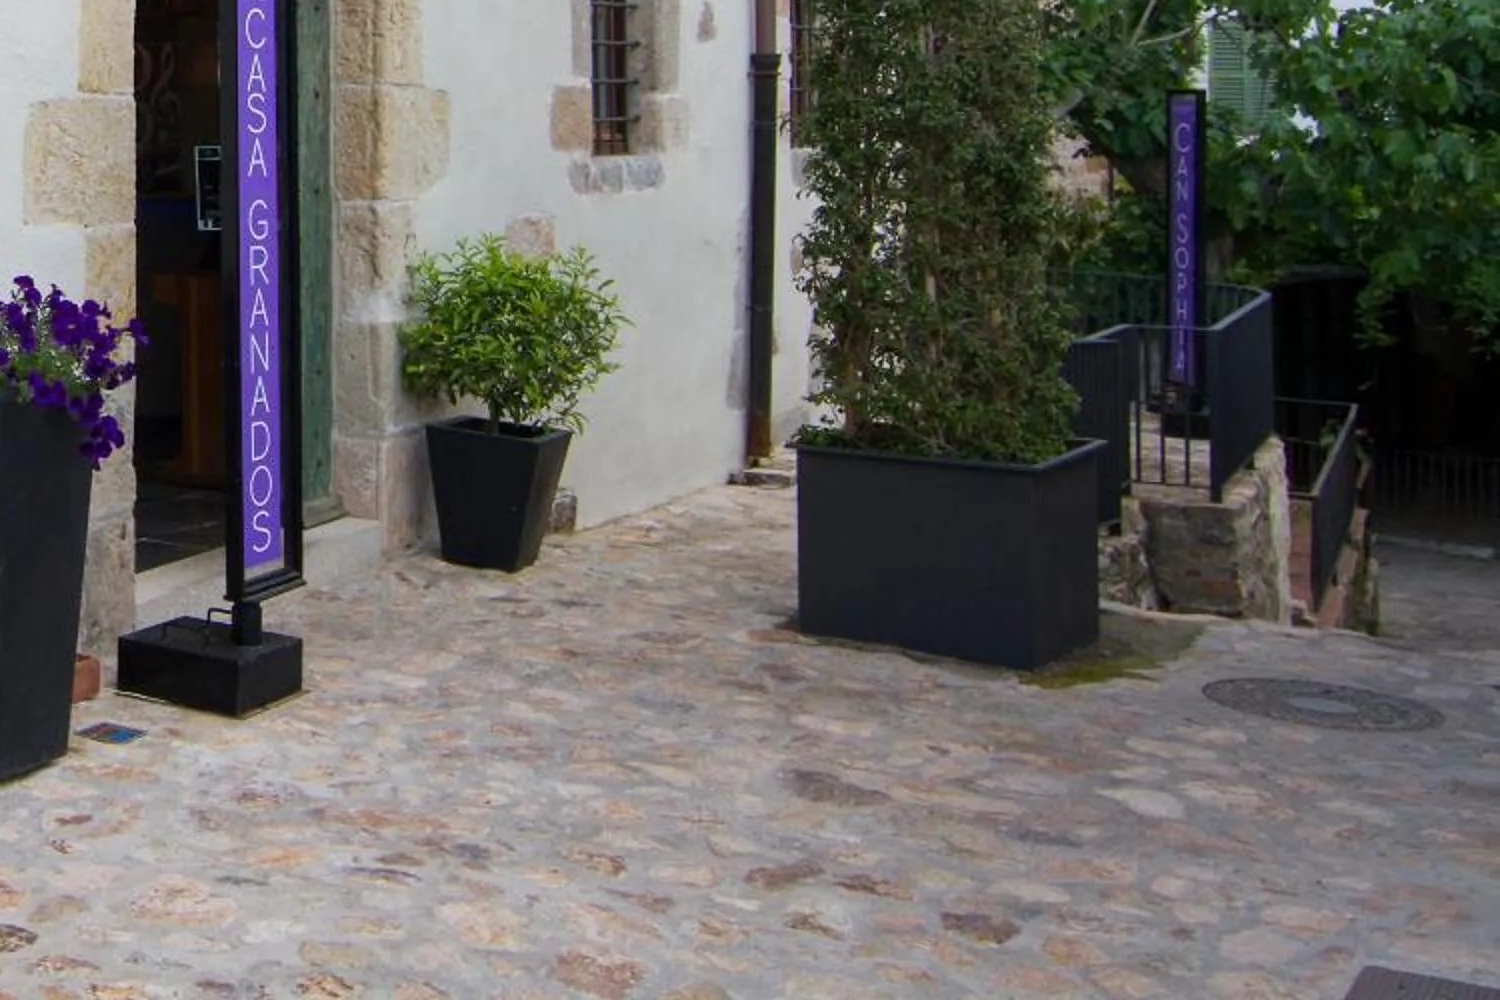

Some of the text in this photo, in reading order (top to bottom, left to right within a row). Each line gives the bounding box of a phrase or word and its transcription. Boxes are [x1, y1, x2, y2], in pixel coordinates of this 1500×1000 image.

[245, 7, 268, 178] CASA
[1173, 122, 1192, 370] CAN SOPHIA
[248, 199, 273, 553] GRANADOS
